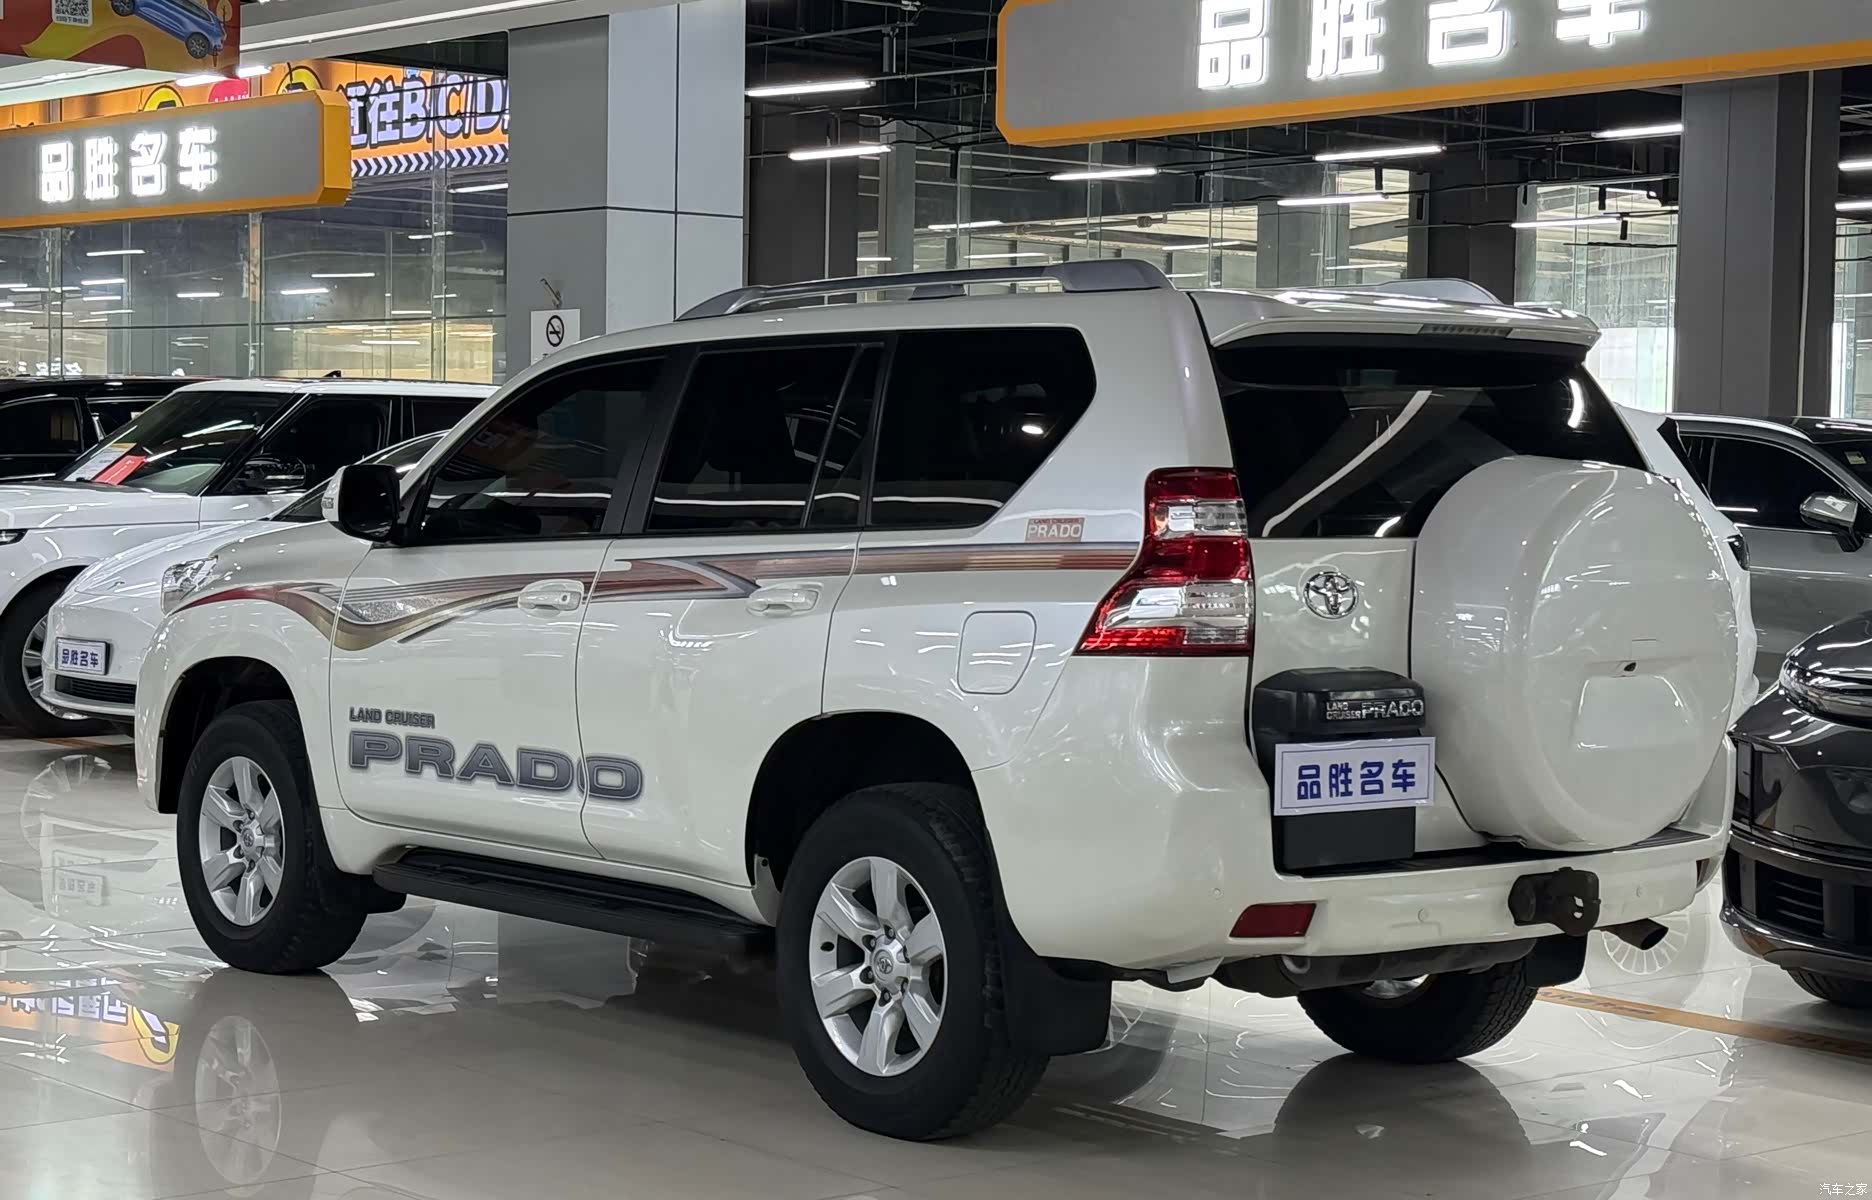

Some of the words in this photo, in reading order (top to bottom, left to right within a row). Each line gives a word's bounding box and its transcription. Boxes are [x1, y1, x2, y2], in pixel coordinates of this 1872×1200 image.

[40, 126, 217, 203] 品胜名车
[1026, 524, 1082, 538] PRADO
[61, 648, 99, 668] 品胜名车
[349, 706, 382, 723] LAND
[384, 709, 436, 729] CRUISER
[1361, 699, 1424, 719] PRADO
[350, 730, 643, 801] PRADO
[1296, 759, 1416, 800] 品胜名车
